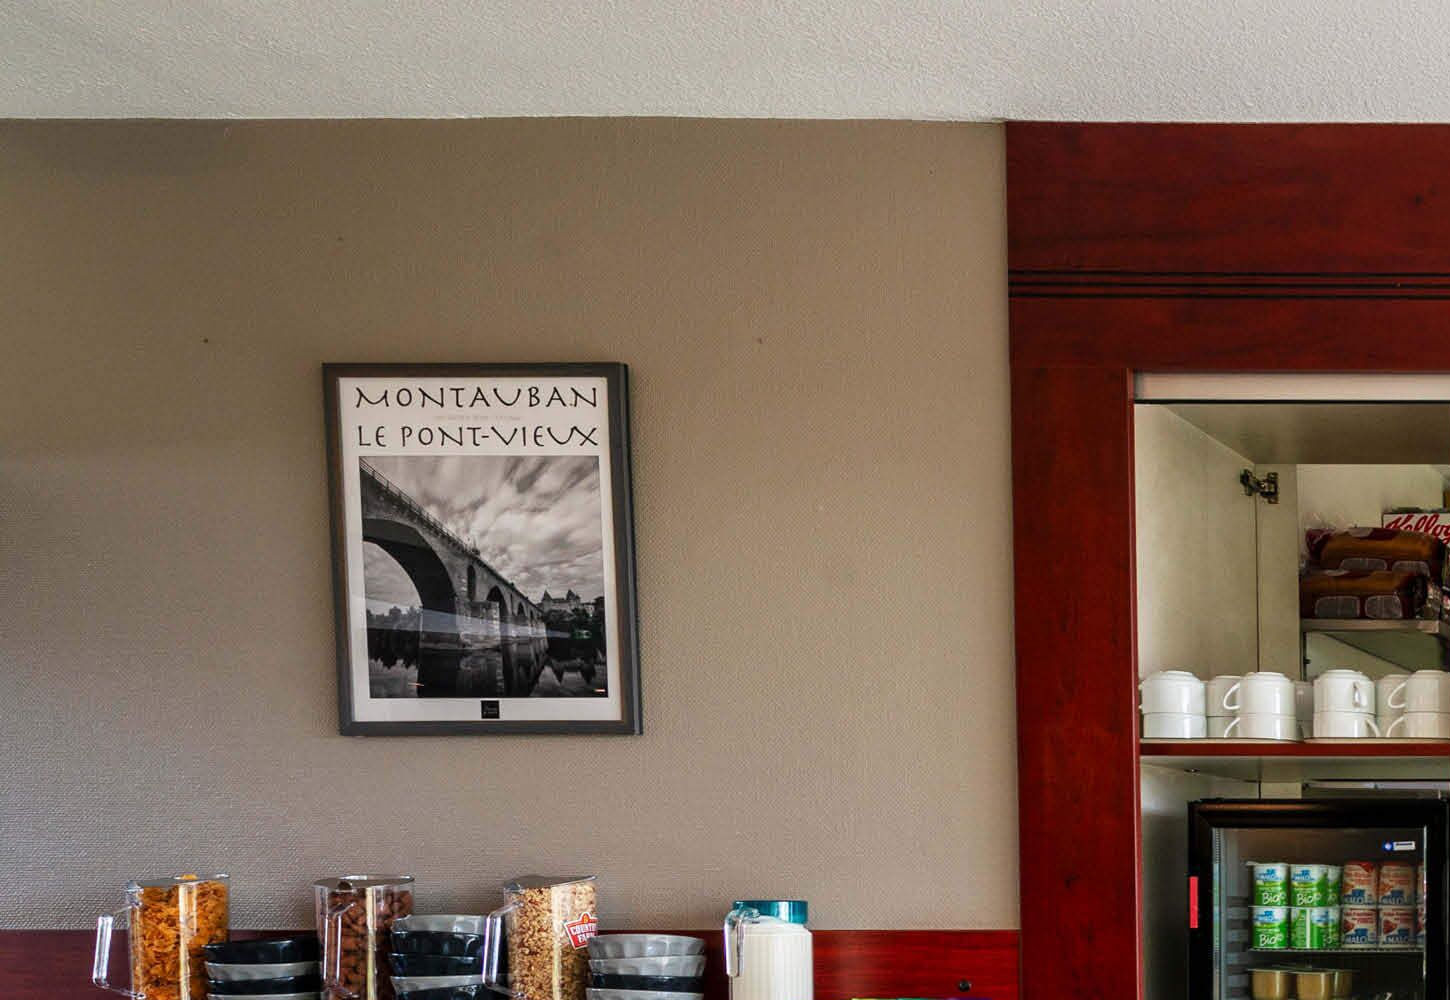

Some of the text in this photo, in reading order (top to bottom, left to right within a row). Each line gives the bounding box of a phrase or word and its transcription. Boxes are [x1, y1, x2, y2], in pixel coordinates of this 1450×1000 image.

[355, 386, 598, 409] MONTAUBAN
[358, 425, 600, 447] LE PONT-VIEUX
